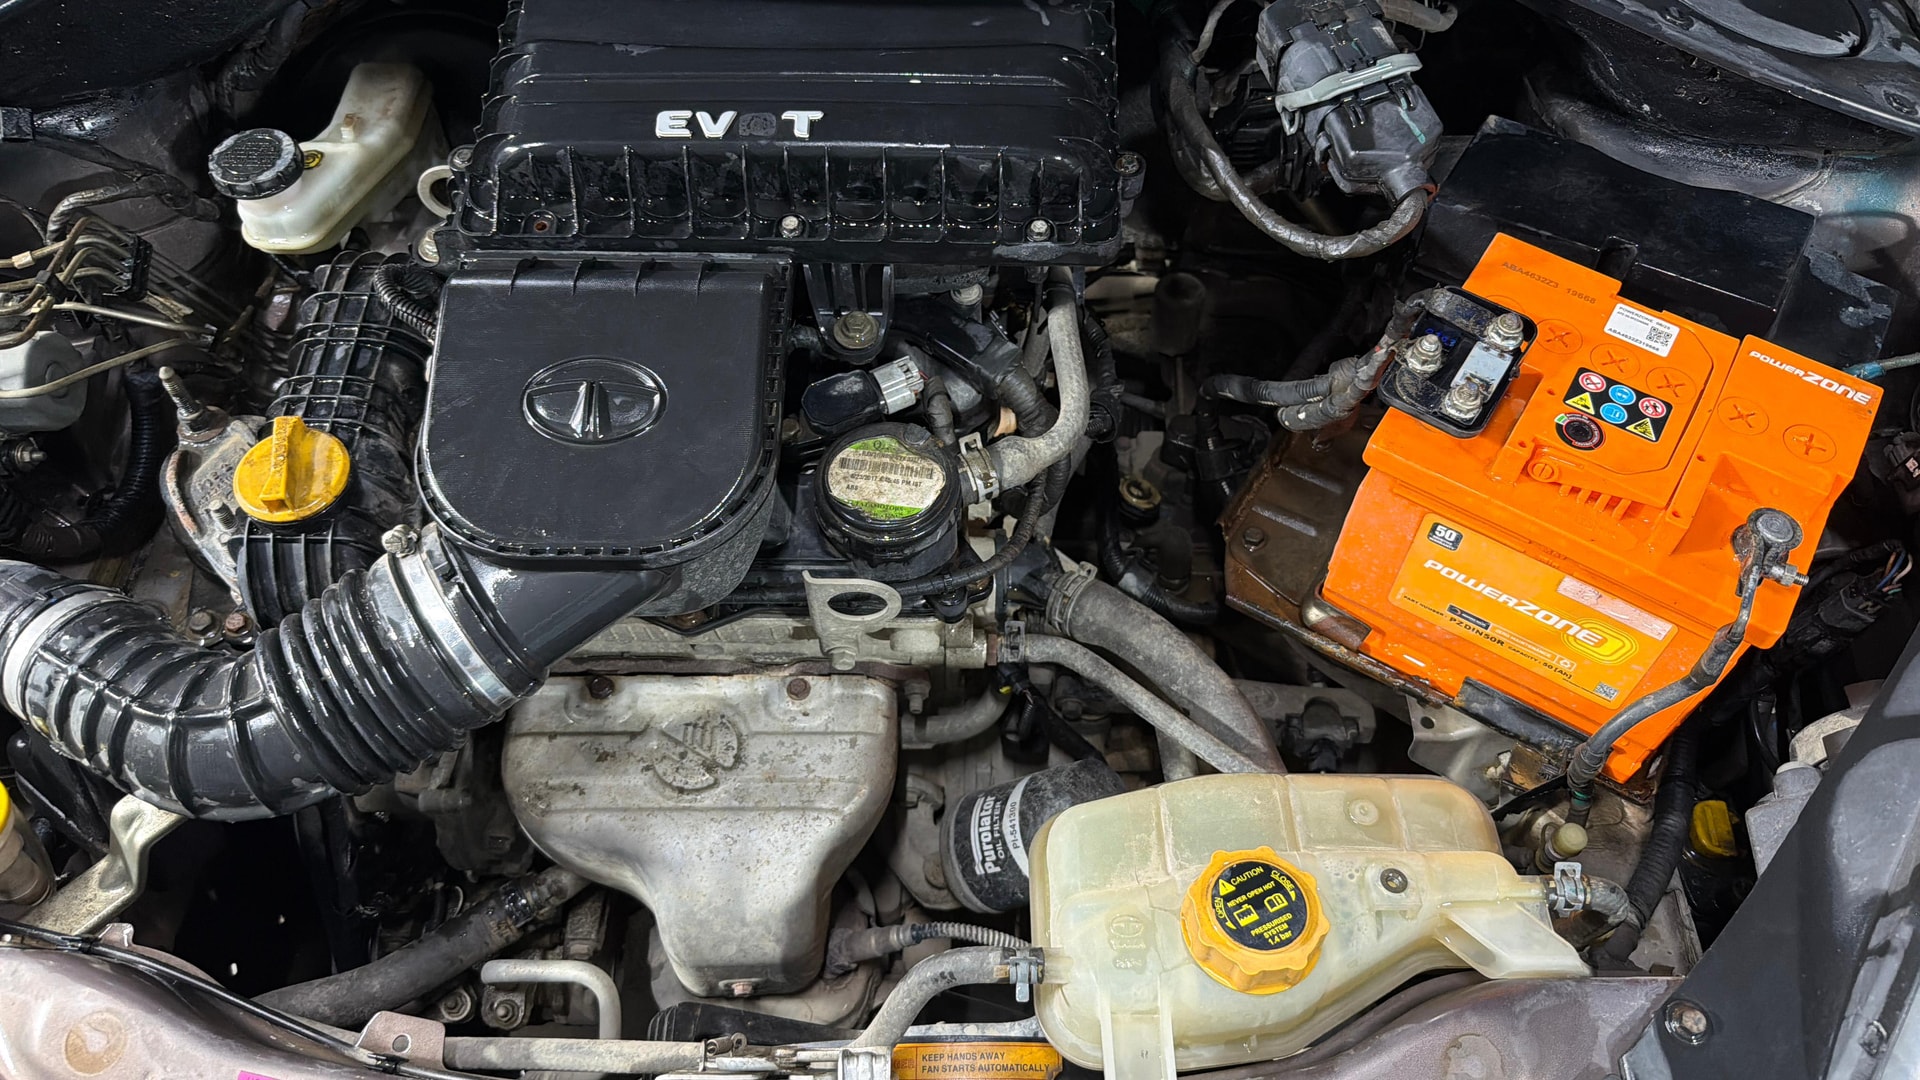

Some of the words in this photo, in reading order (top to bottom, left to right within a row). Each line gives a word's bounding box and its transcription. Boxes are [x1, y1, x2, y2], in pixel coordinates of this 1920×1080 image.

[1749, 350, 1872, 405] POWERZONE
[1434, 524, 1457, 542] 50
[1424, 559, 1604, 647] POWERZONE
[1449, 617, 1505, 647] PZDIN50R
[1542, 662, 1554, 670] 50
[993, 801, 1002, 838] FILTER
[979, 796, 1002, 874] Purolator
[995, 839, 1006, 859] OIL
[1231, 866, 1264, 885] CAUTION
[1270, 870, 1295, 891] CLOSE
[1227, 895, 1247, 908] NEVER
[1246, 887, 1263, 899] OPEN
[1262, 881, 1276, 892] HOT
[1214, 897, 1224, 919] OPEN
[1250, 913, 1293, 936] PRESSURISED
[1263, 923, 1289, 939] SYSTEM
[1268, 934, 1280, 945] 1.4
[1279, 931, 1293, 941] bar
[922, 1054, 945, 1062] KEEP
[947, 1053, 977, 1062] HANDS
[979, 1052, 1005, 1061] AWAY
[922, 1065, 939, 1074] FAN
[942, 1064, 975, 1073] STARTS
[977, 1063, 1050, 1073] AUTOMATICALLY
